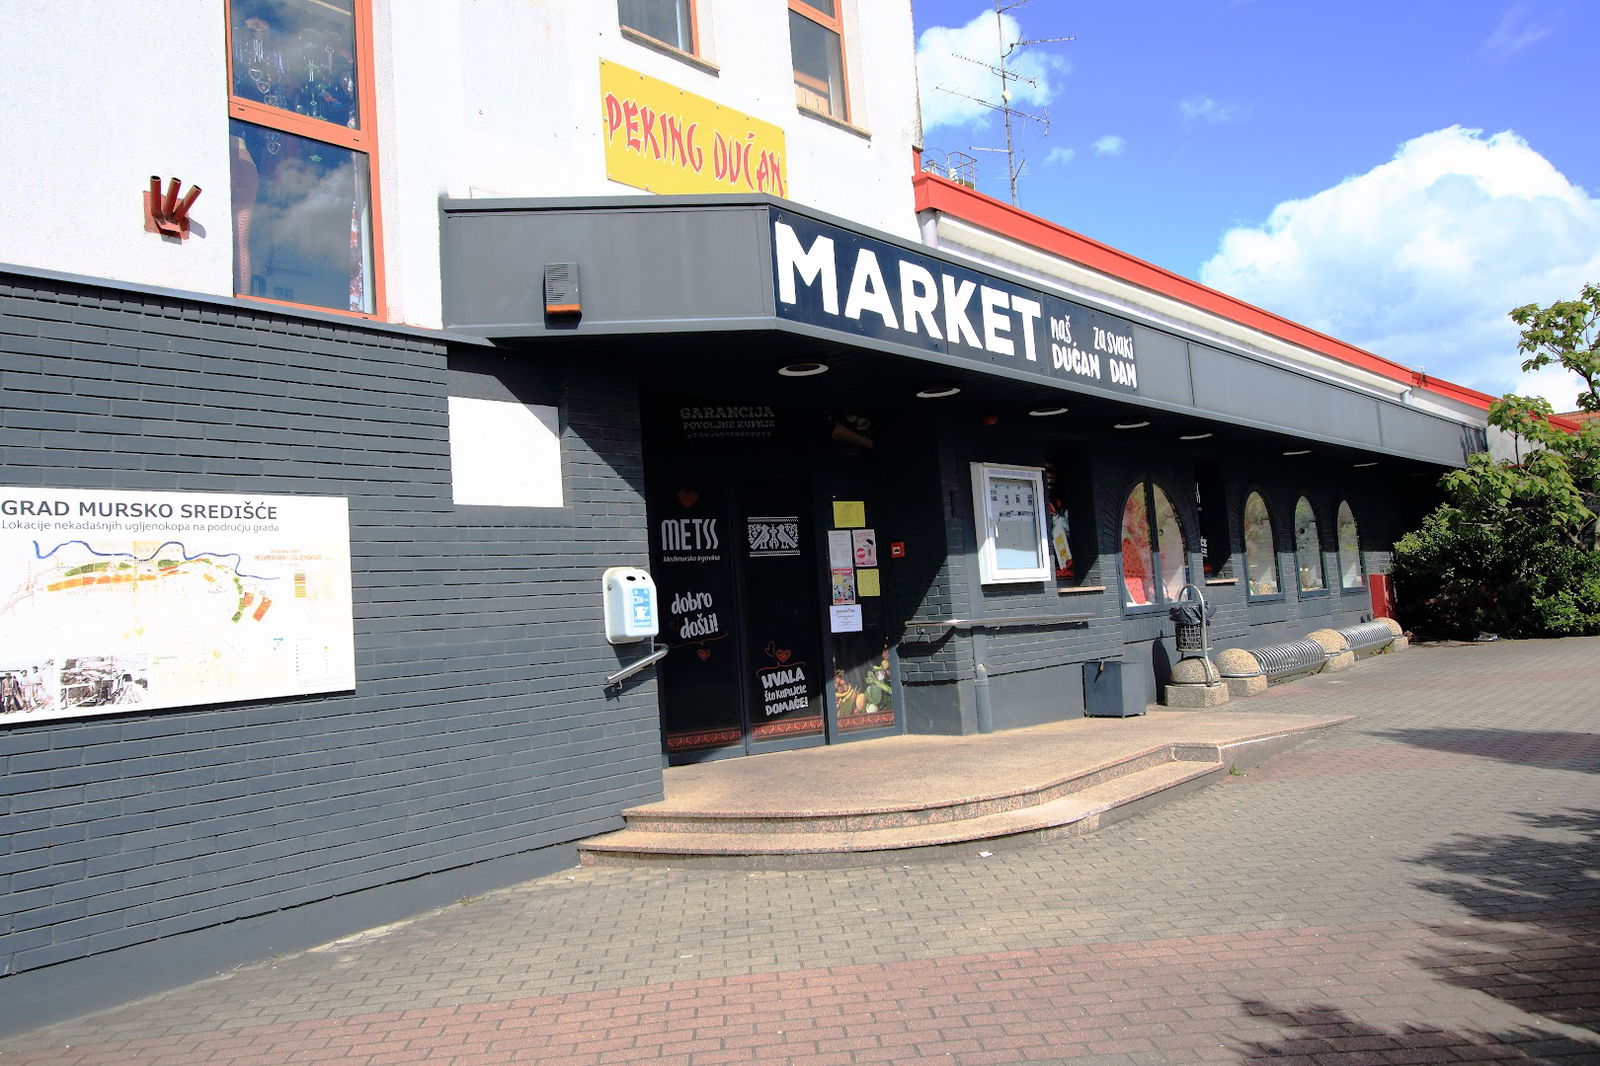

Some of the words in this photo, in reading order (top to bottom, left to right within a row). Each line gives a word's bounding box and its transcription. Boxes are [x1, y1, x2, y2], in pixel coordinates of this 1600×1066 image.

[604, 92, 704, 174] PEKING
[713, 128, 785, 200] DUĆAN
[774, 220, 1042, 362] MARKET
[1051, 341, 1101, 380] DUĆAN
[1109, 358, 1138, 389] DAN
[679, 405, 776, 420] GARANCIJA
[1, 499, 70, 517] GRAD
[79, 502, 174, 519] MURSKO
[180, 501, 278, 520] SREDIŠĆE
[2, 519, 52, 531] Lokacije
[54, 520, 122, 532] nekadašnjih
[125, 521, 191, 533] ugljenokopa
[253, 522, 280, 533] grada
[661, 518, 719, 551] METSS
[671, 591, 713, 615] dobro
[761, 667, 806, 689] HVALA
